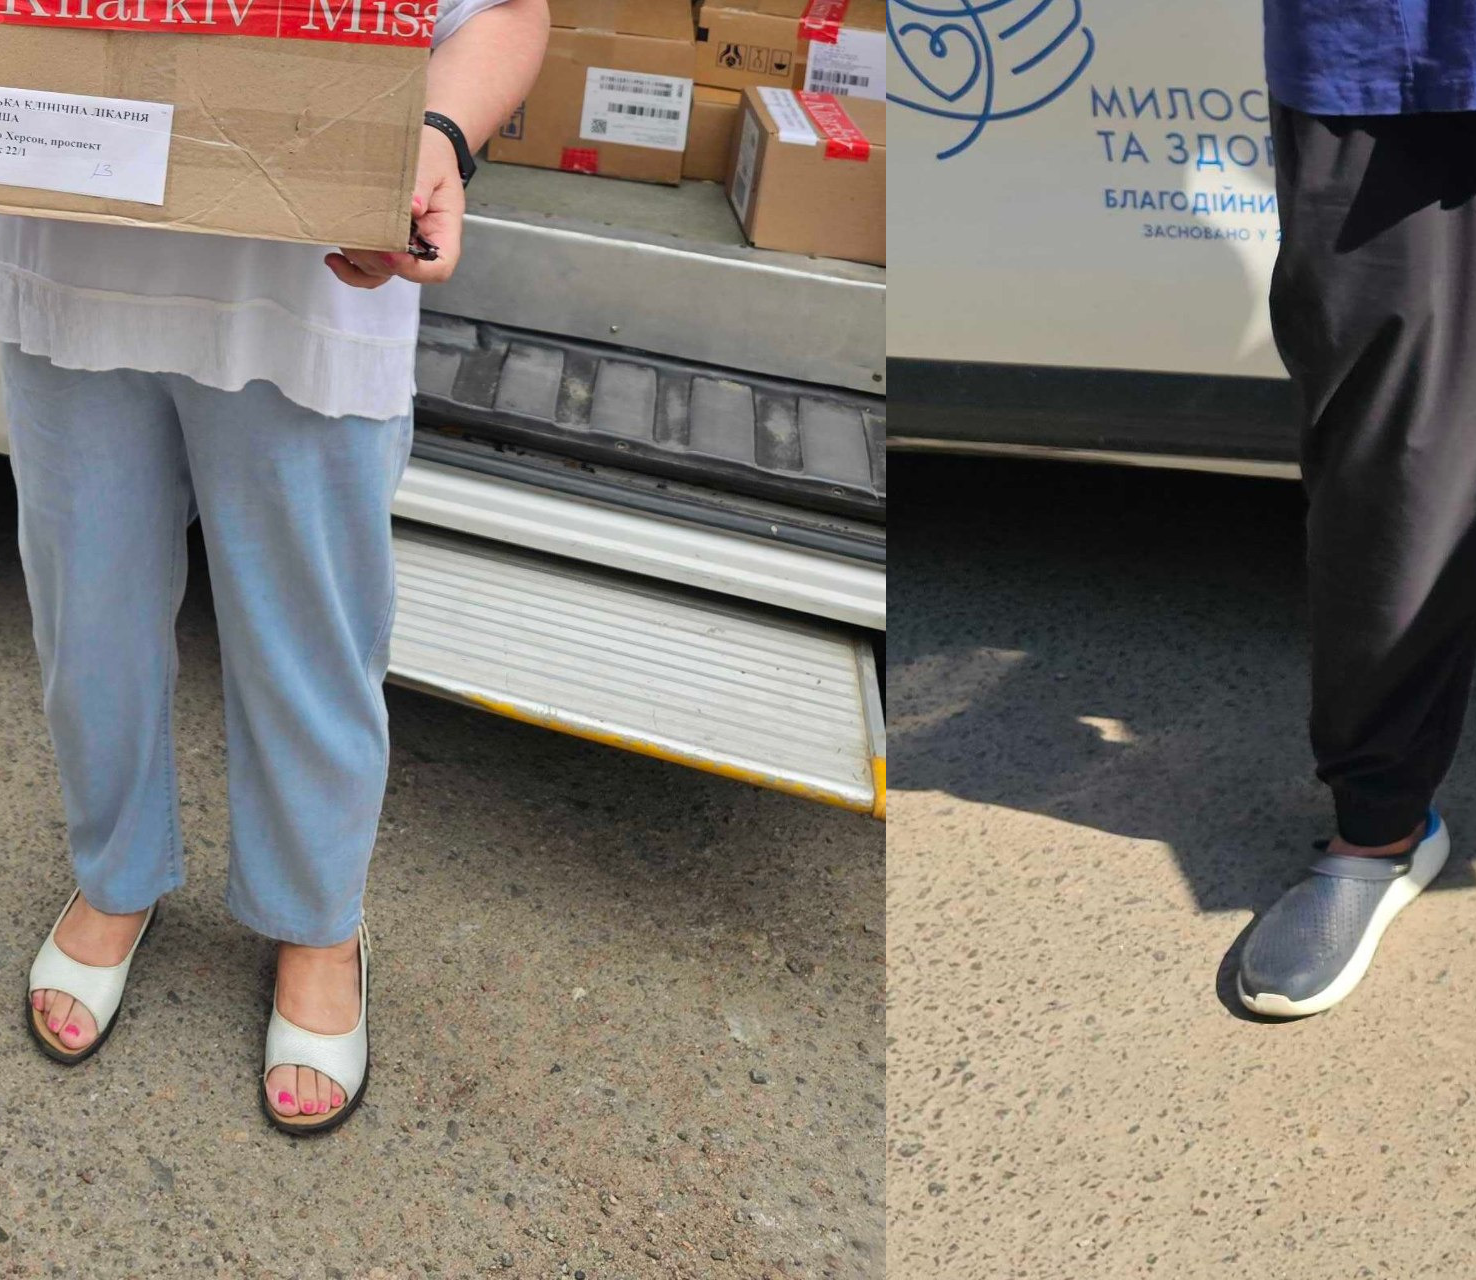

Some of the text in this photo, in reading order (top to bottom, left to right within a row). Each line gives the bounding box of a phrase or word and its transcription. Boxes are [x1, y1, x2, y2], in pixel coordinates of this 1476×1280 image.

[24, 99, 88, 117] КЛІНІЧНА
[90, 107, 150, 123] ЛІКАРНЯ
[1091, 84, 1269, 123] МИЛОС
[6, 131, 48, 147] Херсон,
[50, 138, 102, 152] проспект
[6, 145, 27, 157] 22/1
[1096, 130, 1150, 164] ТА
[1105, 185, 1277, 215] БЛАГОДІЙНИ
[1144, 224, 1250, 241] ЗАСНОВАНО
[1257, 229, 1267, 241] У
